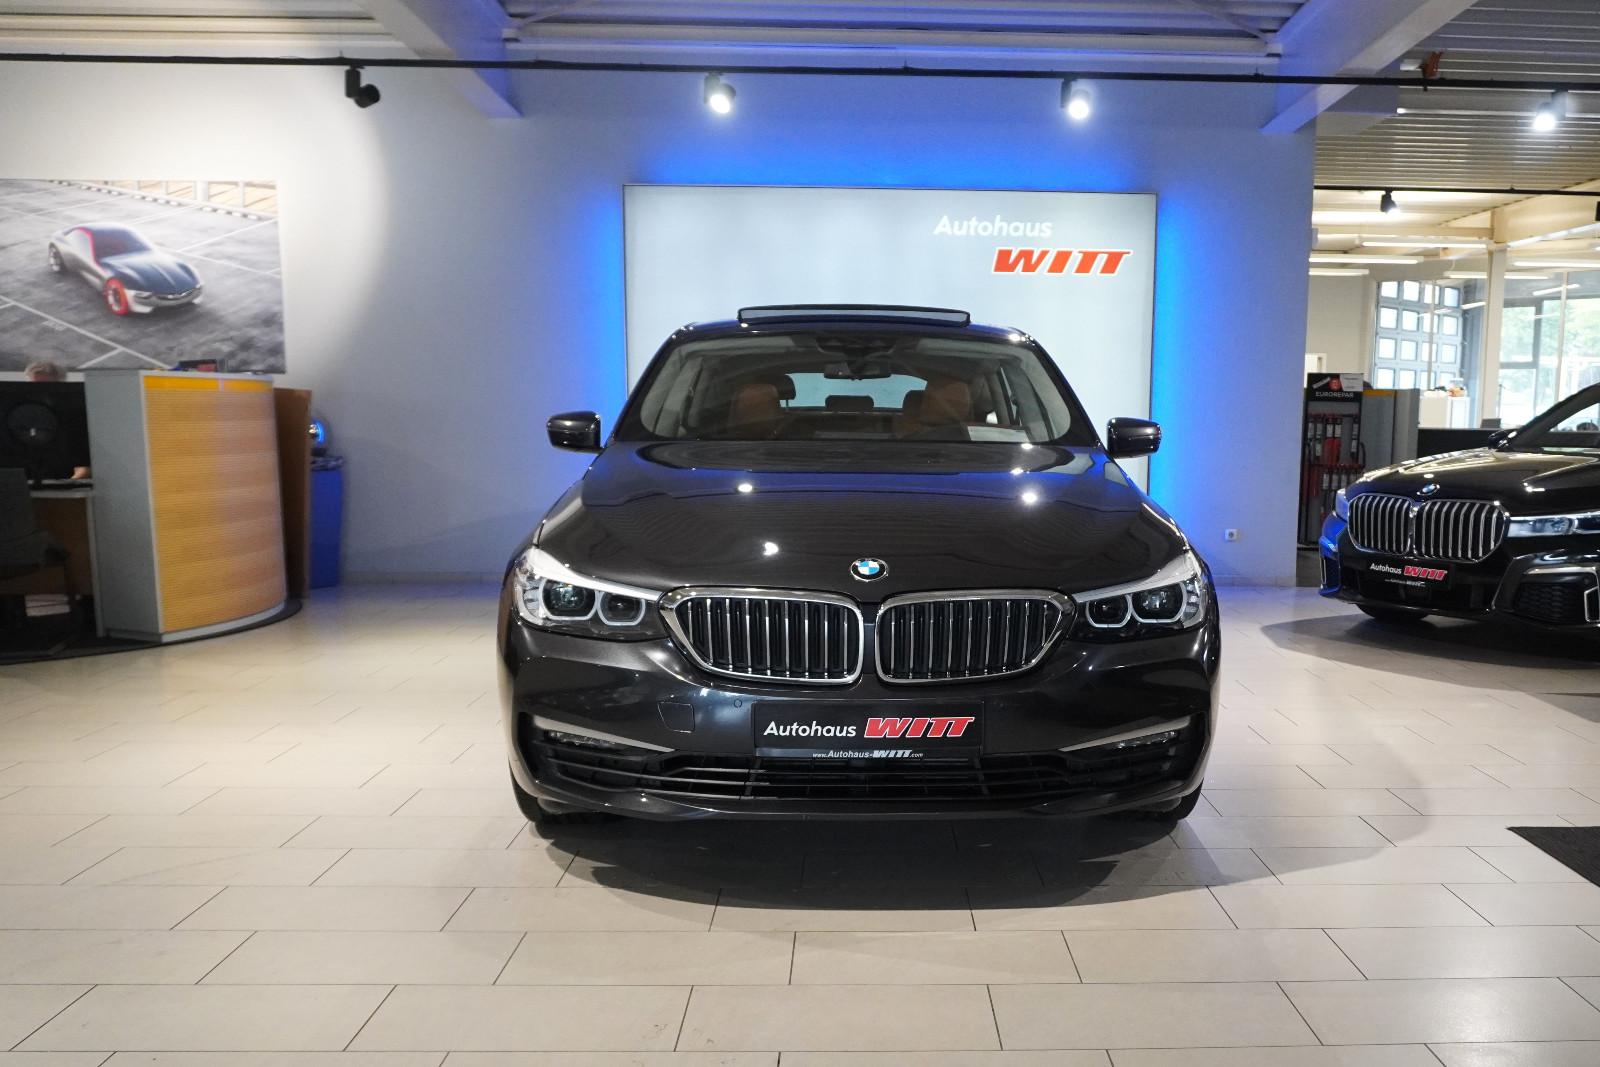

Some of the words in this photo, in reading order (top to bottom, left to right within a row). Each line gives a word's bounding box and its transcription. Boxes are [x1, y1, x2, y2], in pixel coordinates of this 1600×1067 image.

[933, 215, 1052, 236] Autohaus
[992, 247, 1133, 275] WITT
[1370, 563, 1402, 574] Autohaus
[1403, 565, 1448, 580] WITT
[763, 721, 857, 738] Autohaus
[864, 717, 975, 738] WITT
[812, 749, 924, 758] www.Autohaus-WITT.com
